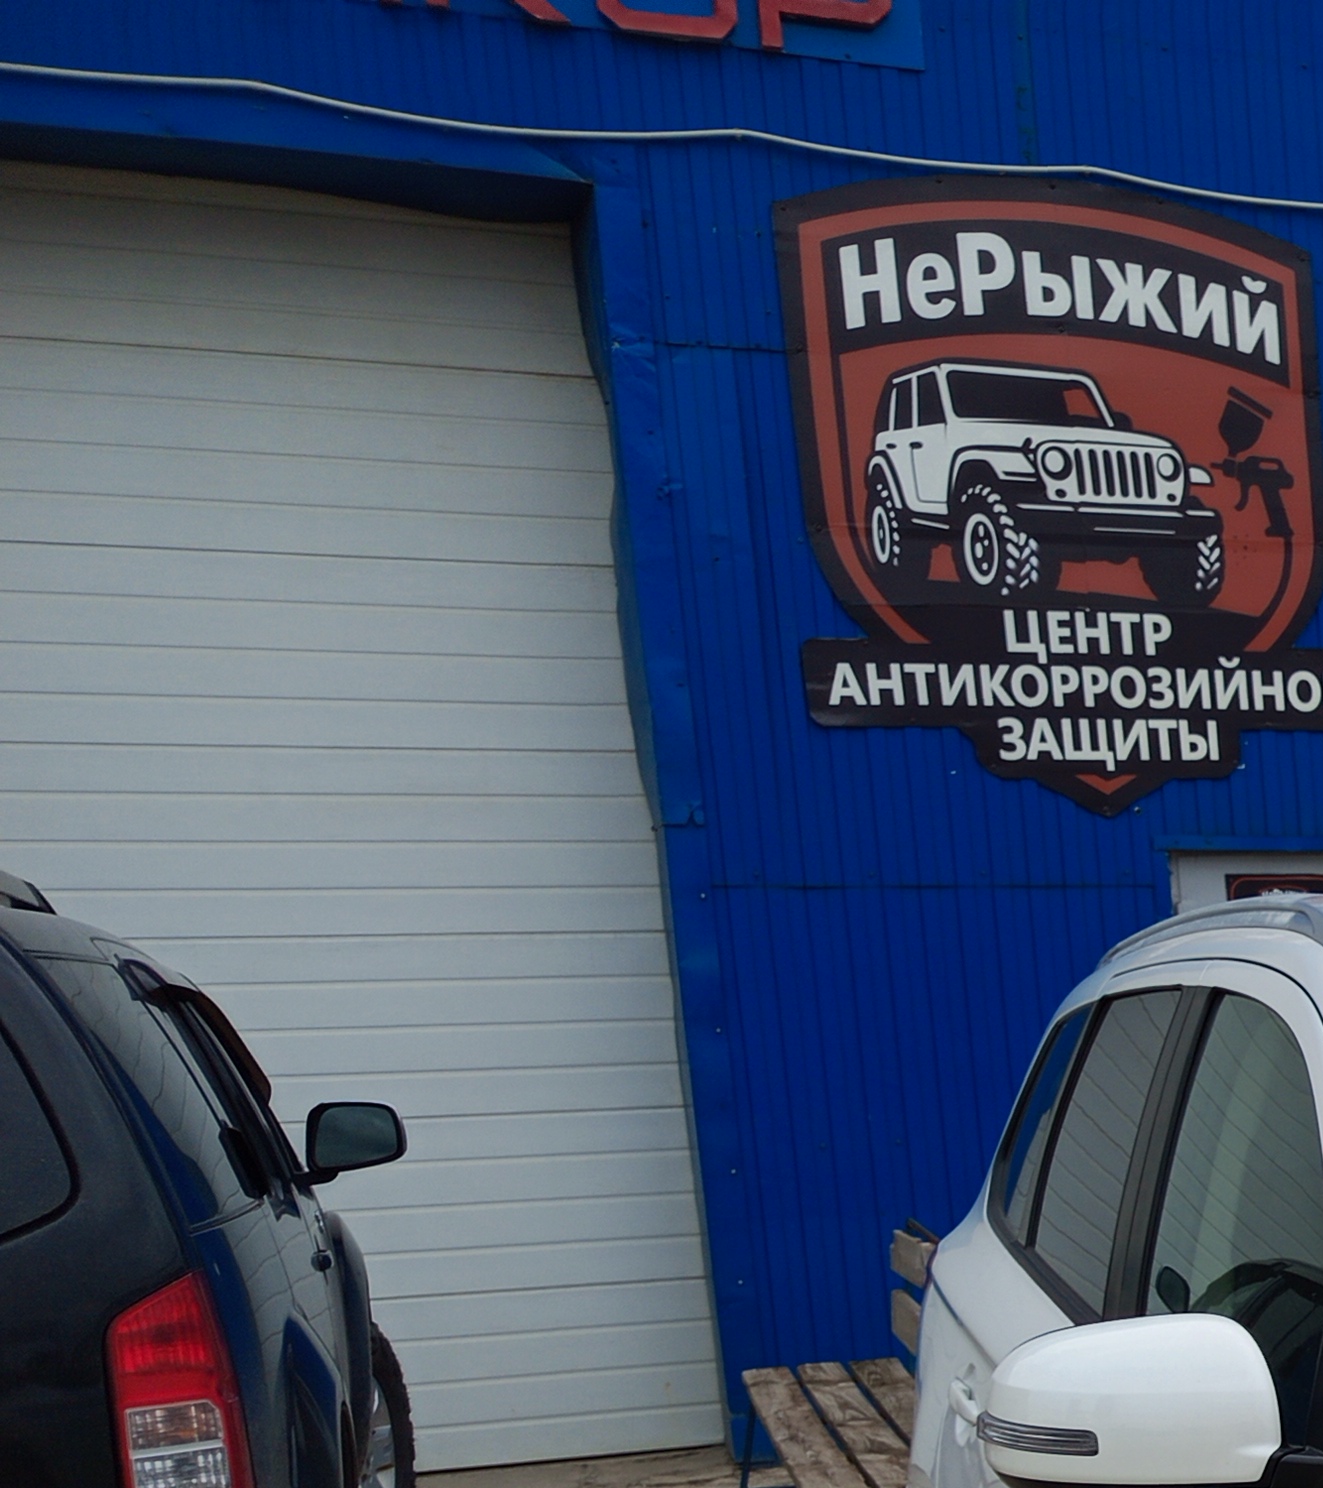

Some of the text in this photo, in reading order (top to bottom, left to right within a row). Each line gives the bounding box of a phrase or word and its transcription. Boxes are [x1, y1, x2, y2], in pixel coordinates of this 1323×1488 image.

[837, 230, 1282, 366] НеРыжий
[1002, 609, 1173, 663] ЦЕНТР
[997, 717, 1221, 772] ЗАЩИТЫ
